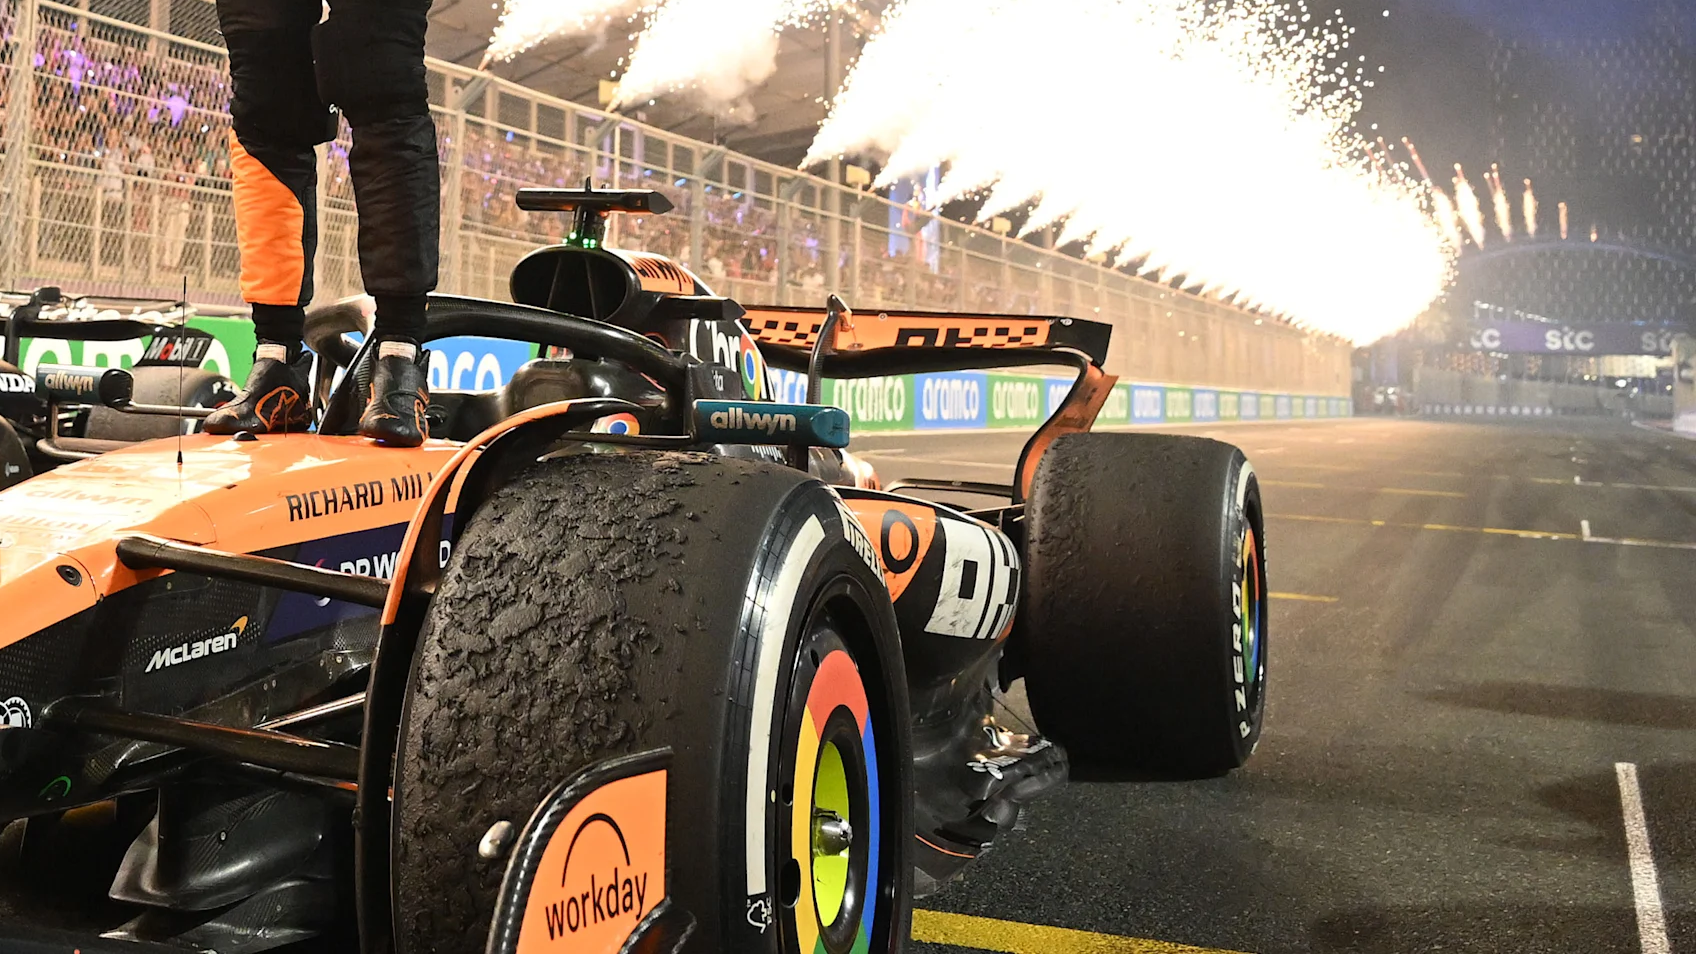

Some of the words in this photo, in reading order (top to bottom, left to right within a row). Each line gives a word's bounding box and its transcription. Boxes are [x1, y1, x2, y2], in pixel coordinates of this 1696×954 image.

[143, 335, 193, 362] Mobil
[1544, 325, 1595, 351] stc
[833, 377, 905, 422] aramco
[922, 378, 980, 421] aramco
[992, 381, 1040, 420] aramco
[710, 407, 797, 436] allwyn
[286, 480, 383, 522] RICHARD
[390, 472, 433, 503] MIL
[143, 632, 237, 674] McLaren
[1231, 581, 1248, 713] ZERO
[545, 867, 647, 942] workday
